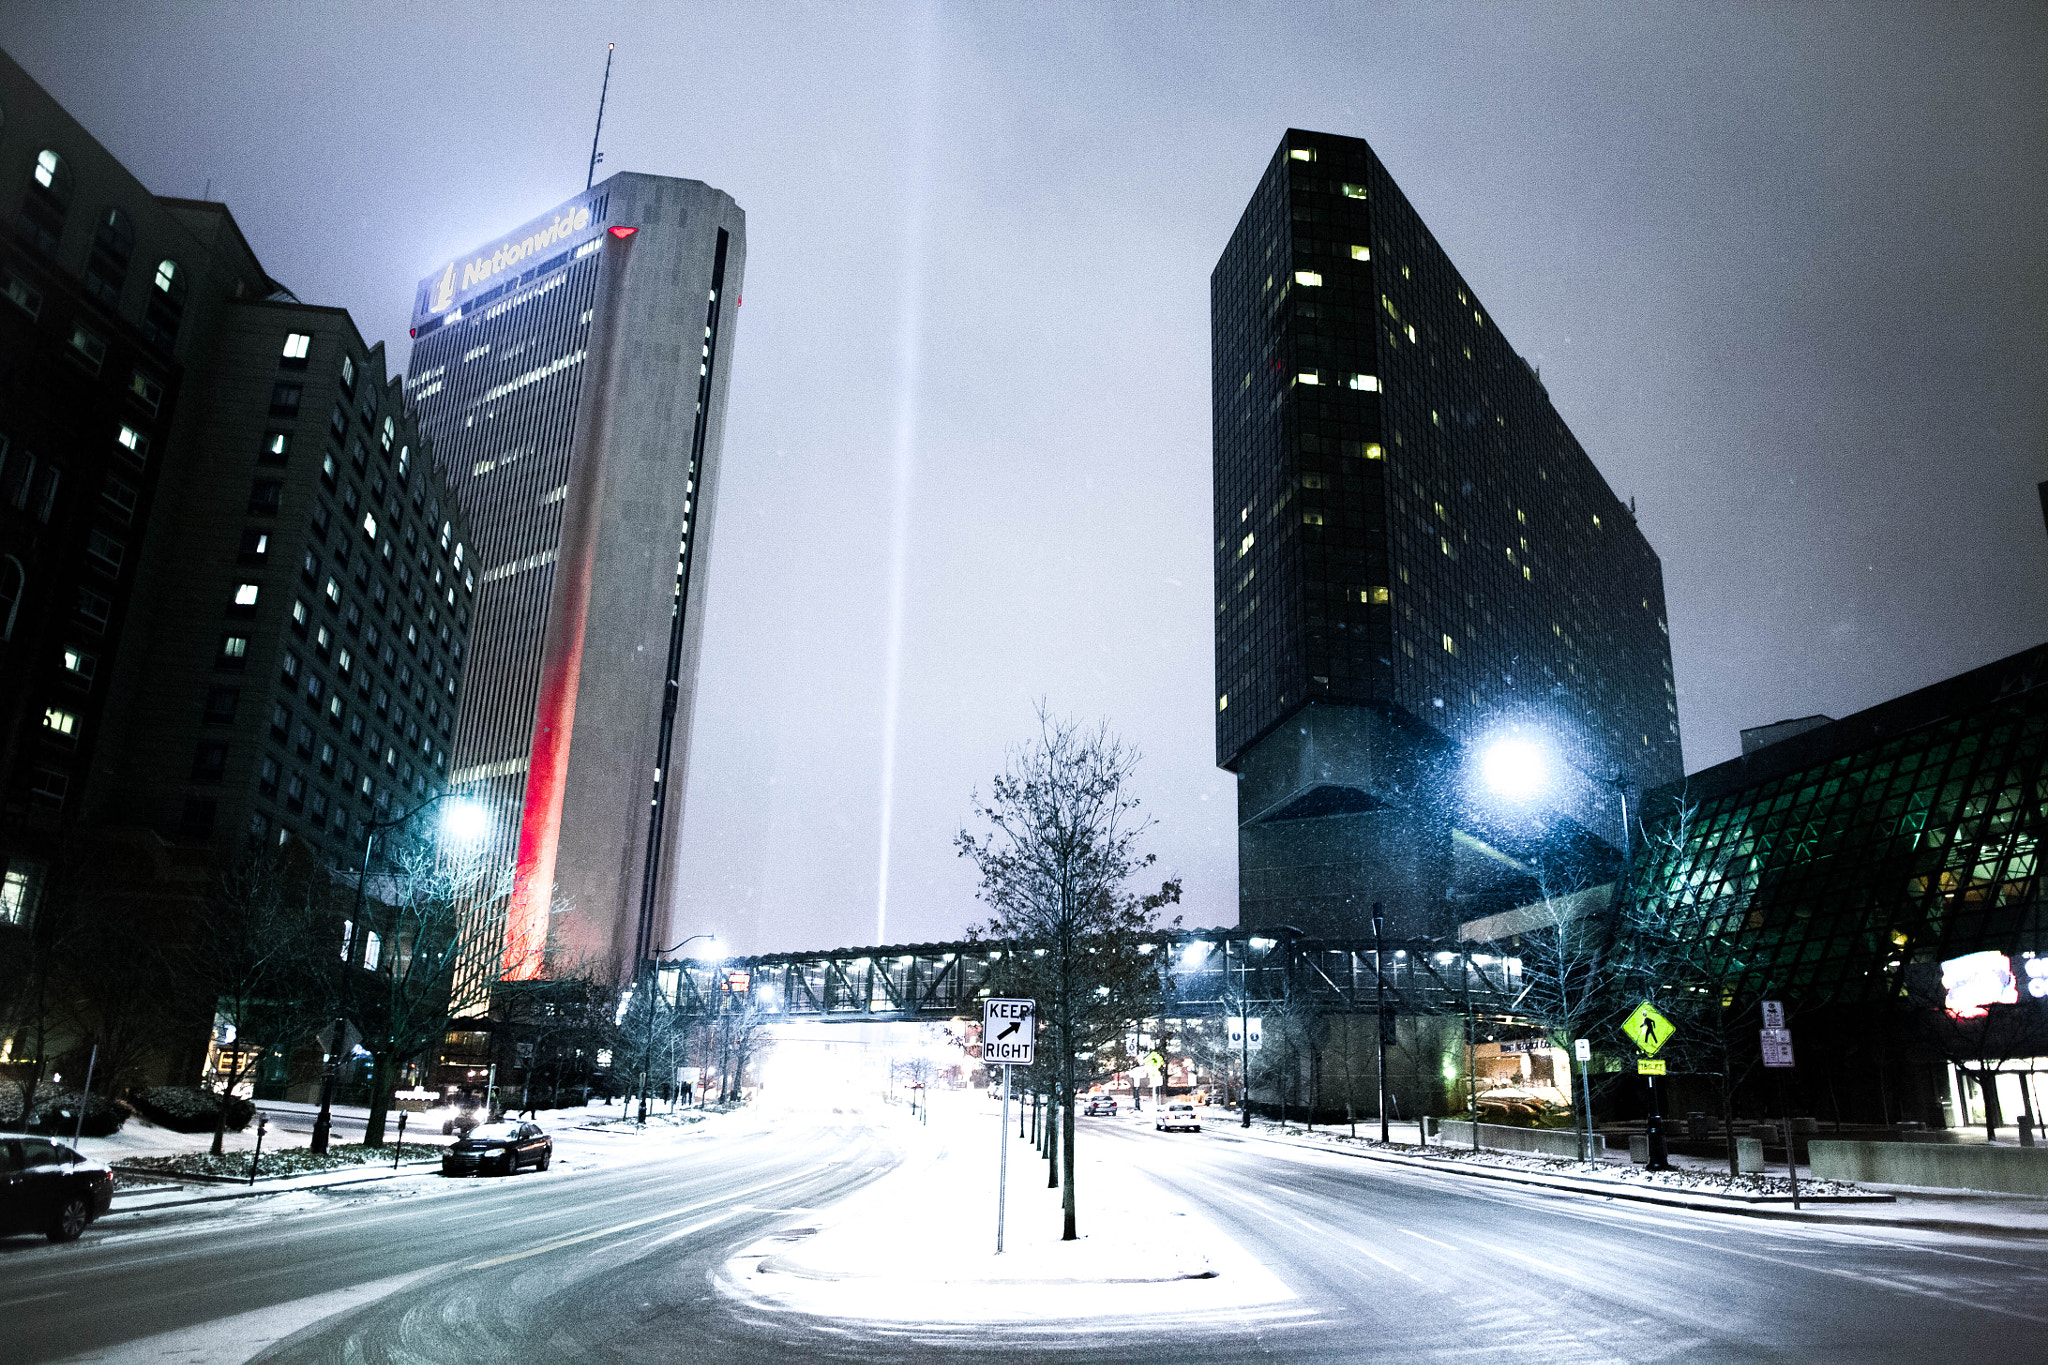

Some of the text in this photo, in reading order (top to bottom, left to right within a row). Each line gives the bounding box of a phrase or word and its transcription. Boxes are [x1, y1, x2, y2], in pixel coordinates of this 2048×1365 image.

[461, 207, 589, 290] Nationwide
[990, 1003, 1030, 1019] KEEP
[986, 1043, 1030, 1059] RIGHT
